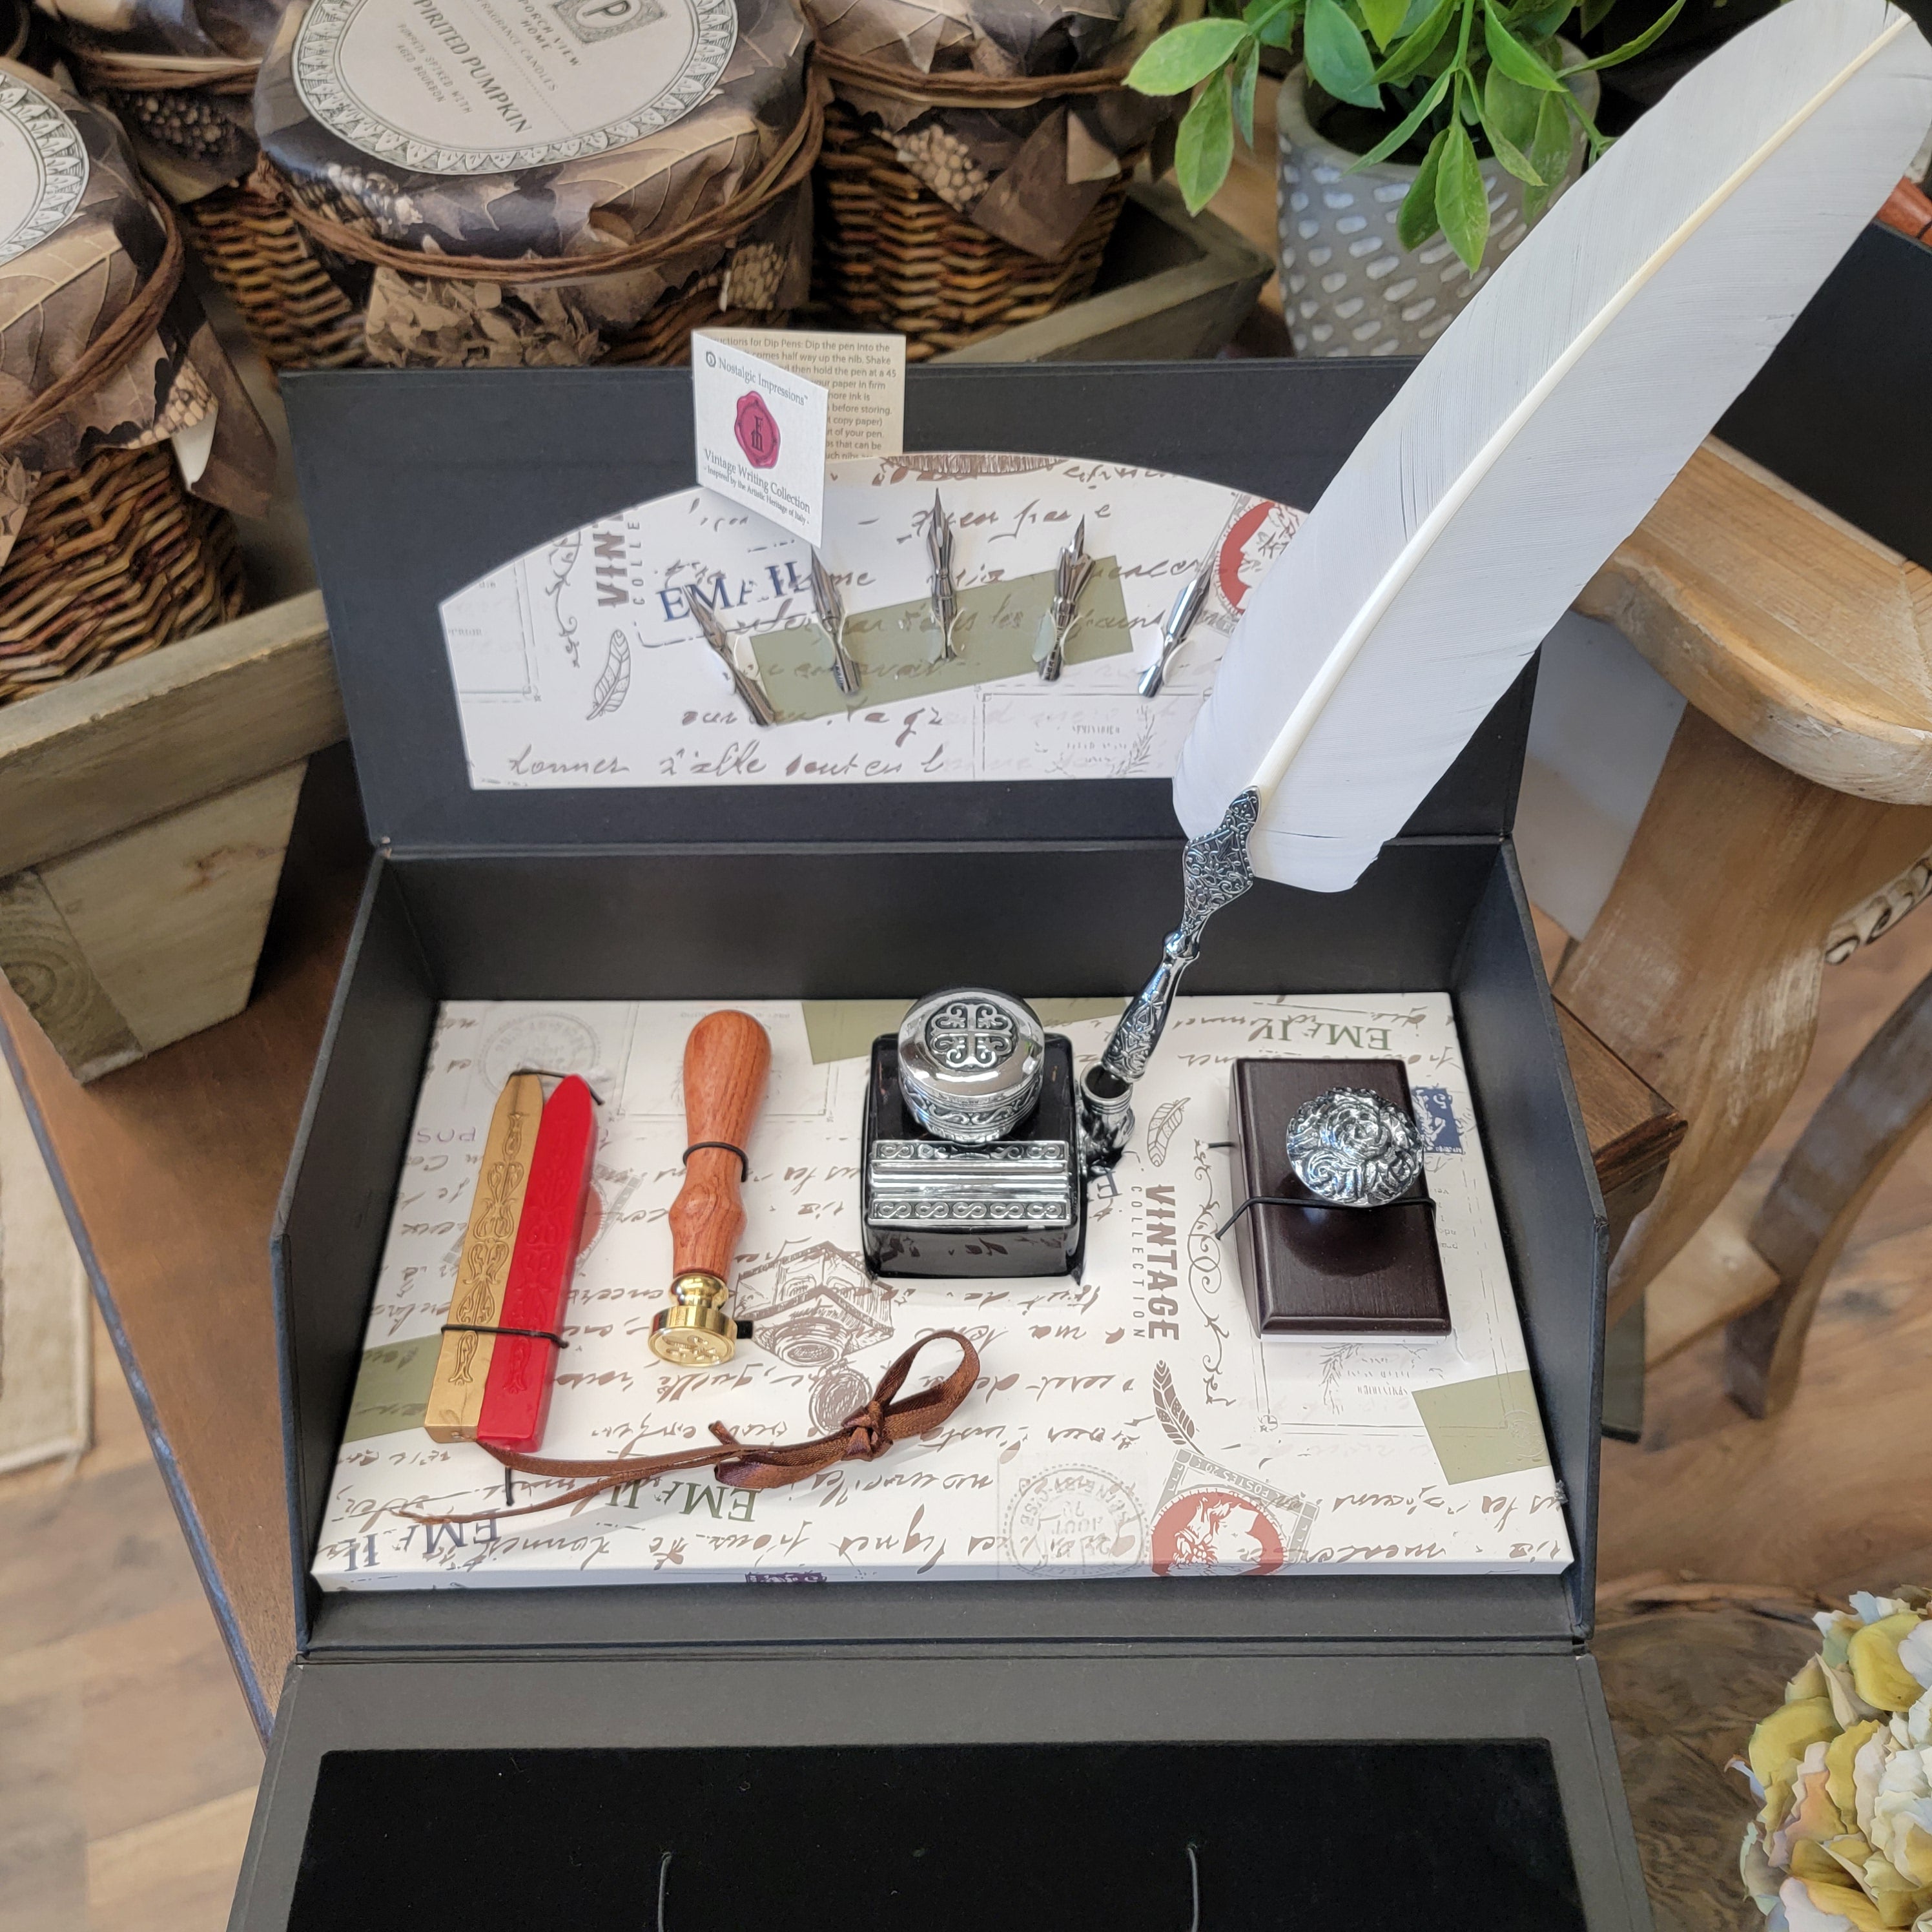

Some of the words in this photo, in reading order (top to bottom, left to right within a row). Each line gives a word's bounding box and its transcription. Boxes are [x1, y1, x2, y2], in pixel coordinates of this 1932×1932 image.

[480, 2, 521, 45] RAGRANCE
[520, 21, 552, 50] HOME
[553, 37, 581, 66] VIEW
[395, 45, 416, 63] AGED
[413, 65, 447, 103] BOURBON
[412, 0, 471, 54] PIRITED
[461, 57, 533, 133] PUMPKIN
[425, 56, 454, 87] SPIKED
[750, 337, 762, 346] for
[764, 338, 779, 349] Dip
[805, 340, 821, 351] Dip
[823, 340, 836, 349] the
[839, 342, 855, 353] pen
[857, 342, 874, 352] into
[876, 343, 890, 353] the
[781, 351, 798, 362] half
[799, 353, 817, 364] way
[818, 355, 830, 365] up
[832, 355, 846, 363] the
[848, 355, 864, 365] nib.
[866, 355, 891, 365] Shake
[719, 357, 756, 384] Nostalgic
[791, 364, 812, 375] then
[813, 365, 833, 375] hold
[834, 367, 848, 376] the
[851, 368, 867, 378] pen
[868, 368, 877, 377] at
[886, 369, 897, 378] 45
[832, 380, 857, 389] paper
[859, 380, 867, 389] in
[868, 381, 886, 389] firm
[832, 403, 859, 413] before
[861, 405, 892, 416] storing.
[849, 392, 861, 401] ink
[864, 393, 870, 402] is
[834, 416, 854, 427] copy
[855, 417, 883, 427] paper)
[834, 427, 843, 437] of
[845, 429, 864, 439] your
[836, 439, 853, 449] that
[854, 441, 869, 449] can
[871, 442, 882, 451] be
[704, 448, 737, 475] Vintage
[738, 464, 770, 495] Writing
[771, 482, 811, 514] Collection
[708, 465, 730, 482] Inspired
[730, 475, 737, 488] by
[737, 480, 746, 491] the
[747, 486, 765, 502] Artistic
[766, 495, 788, 515] Heritage
[788, 508, 795, 517] of
[795, 511, 807, 526] Italy
[591, 514, 630, 608] VIN
[1131, 1186, 1146, 1338] COLLECTION
[1146, 1184, 1180, 1341] VINTAGE
